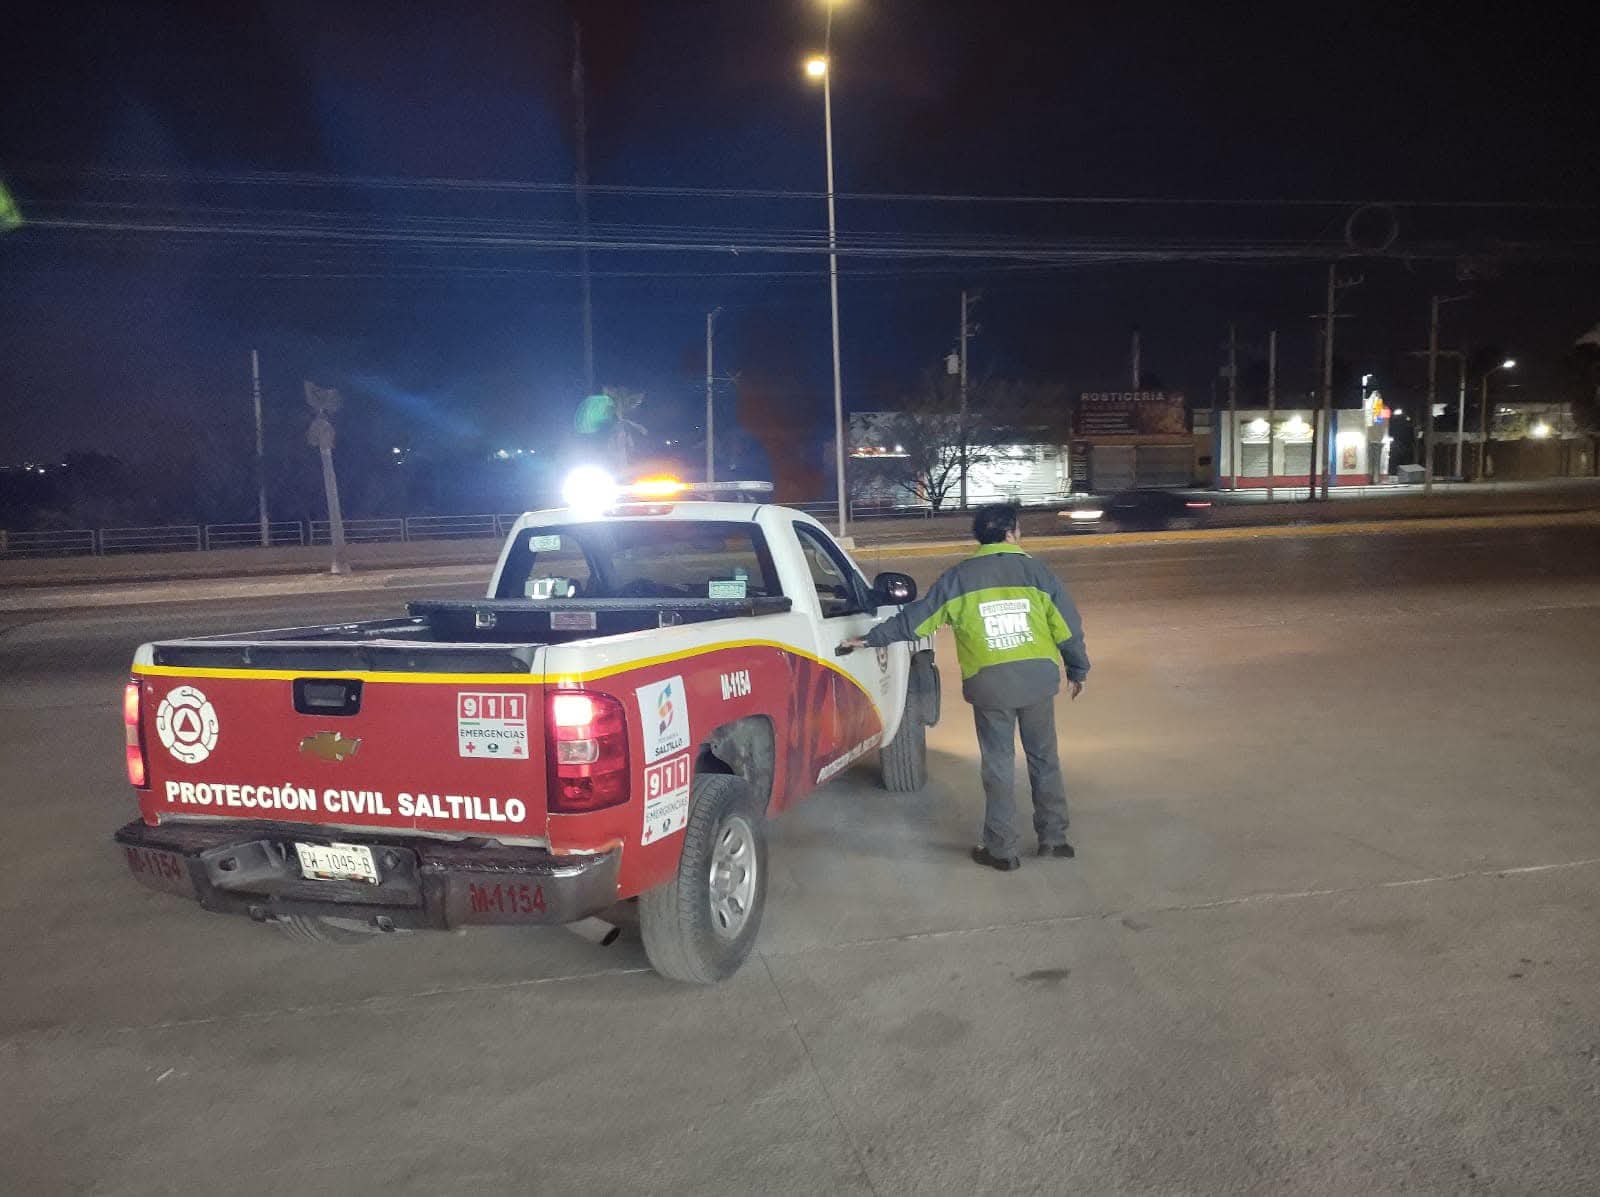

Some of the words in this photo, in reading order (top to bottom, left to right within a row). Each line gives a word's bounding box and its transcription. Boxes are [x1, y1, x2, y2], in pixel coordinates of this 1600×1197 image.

[984, 612, 1030, 637] CIVIL
[720, 670, 752, 700] M-1154
[463, 698, 518, 717] 911
[460, 729, 525, 739] EMERGENCIAS
[655, 739, 684, 757] SALTILLO
[650, 761, 685, 796] 911
[165, 781, 317, 811] PROTECCIÓN
[323, 788, 392, 815] CIVIL
[397, 792, 526, 823] SALTILLO
[127, 848, 182, 879] M-1154
[469, 883, 548, 913] M-1154
